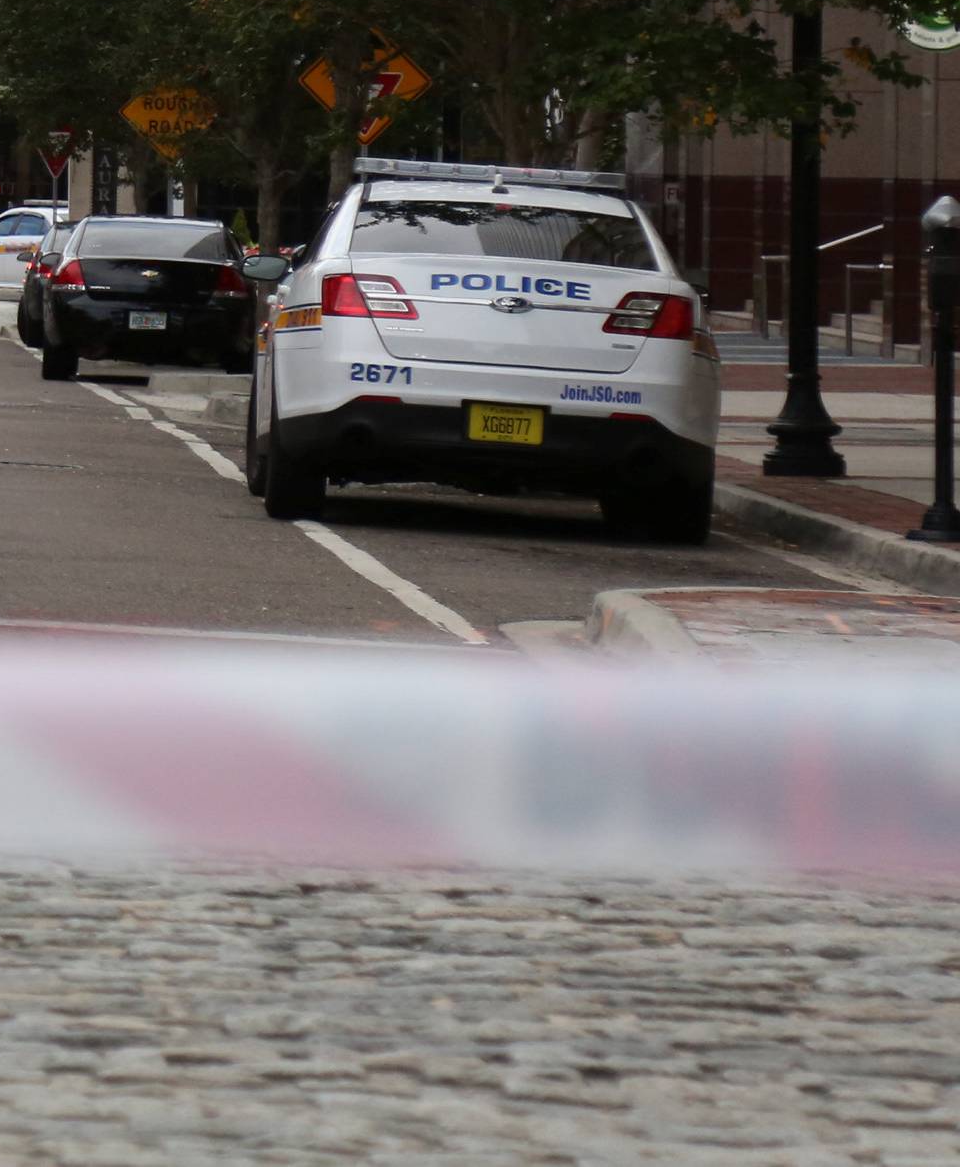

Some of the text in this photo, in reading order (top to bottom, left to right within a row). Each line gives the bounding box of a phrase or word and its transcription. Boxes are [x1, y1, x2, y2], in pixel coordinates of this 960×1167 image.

[431, 274, 591, 300] POLICE
[351, 363, 412, 384] 2671
[560, 385, 642, 404] JoinJSO.com
